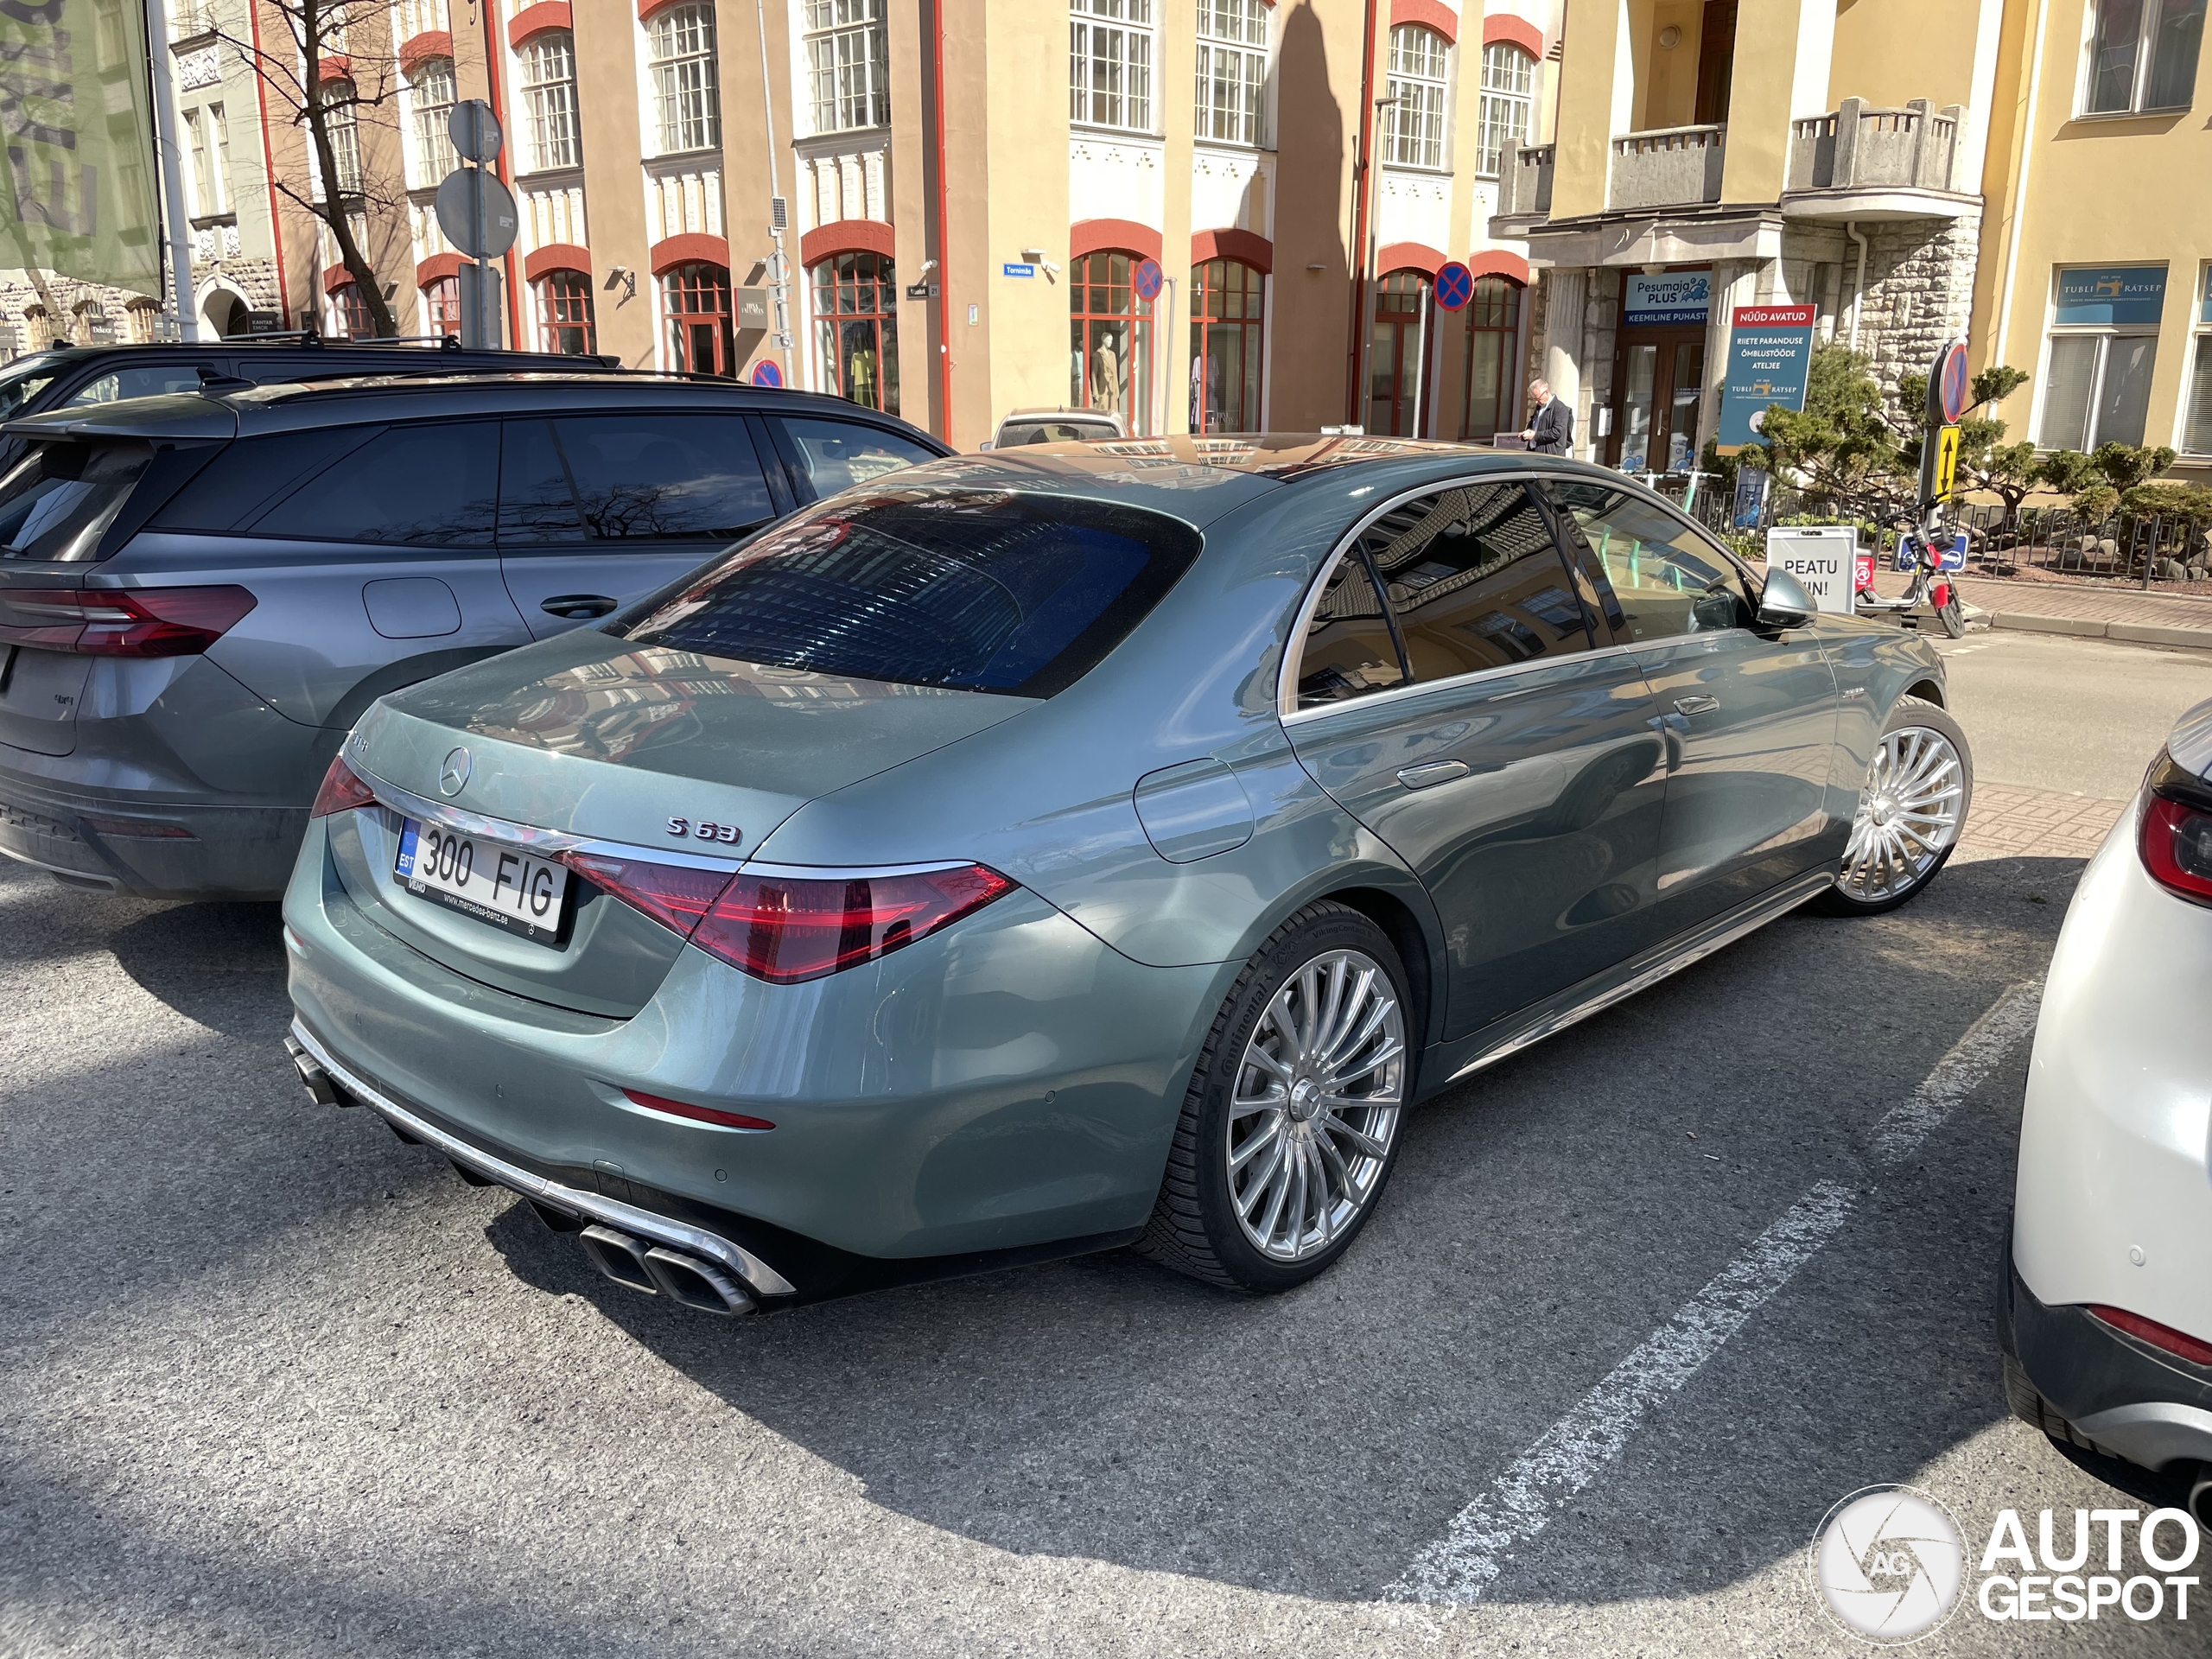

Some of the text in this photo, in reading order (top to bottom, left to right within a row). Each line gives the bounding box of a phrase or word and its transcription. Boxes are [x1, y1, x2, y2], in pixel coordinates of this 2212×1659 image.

[1637, 280, 1690, 294] Pesumaja
[2063, 283, 2162, 294] TUBLI RÄTSEP
[1648, 293, 1677, 304] PLUS
[1628, 313, 1672, 322] KEEMILINE
[1739, 311, 1807, 322] NÜÜD AVATUD
[1784, 560, 1838, 575] PEATU
[1803, 582, 1828, 596] IN!
[664, 816, 741, 844] S 63
[399, 853, 415, 869] EST
[423, 830, 553, 917] 300 FIG
[408, 879, 427, 893] VEHO
[443, 893, 509, 925] www.mercedes-benz.ee
[1221, 982, 1268, 1078] Continental
